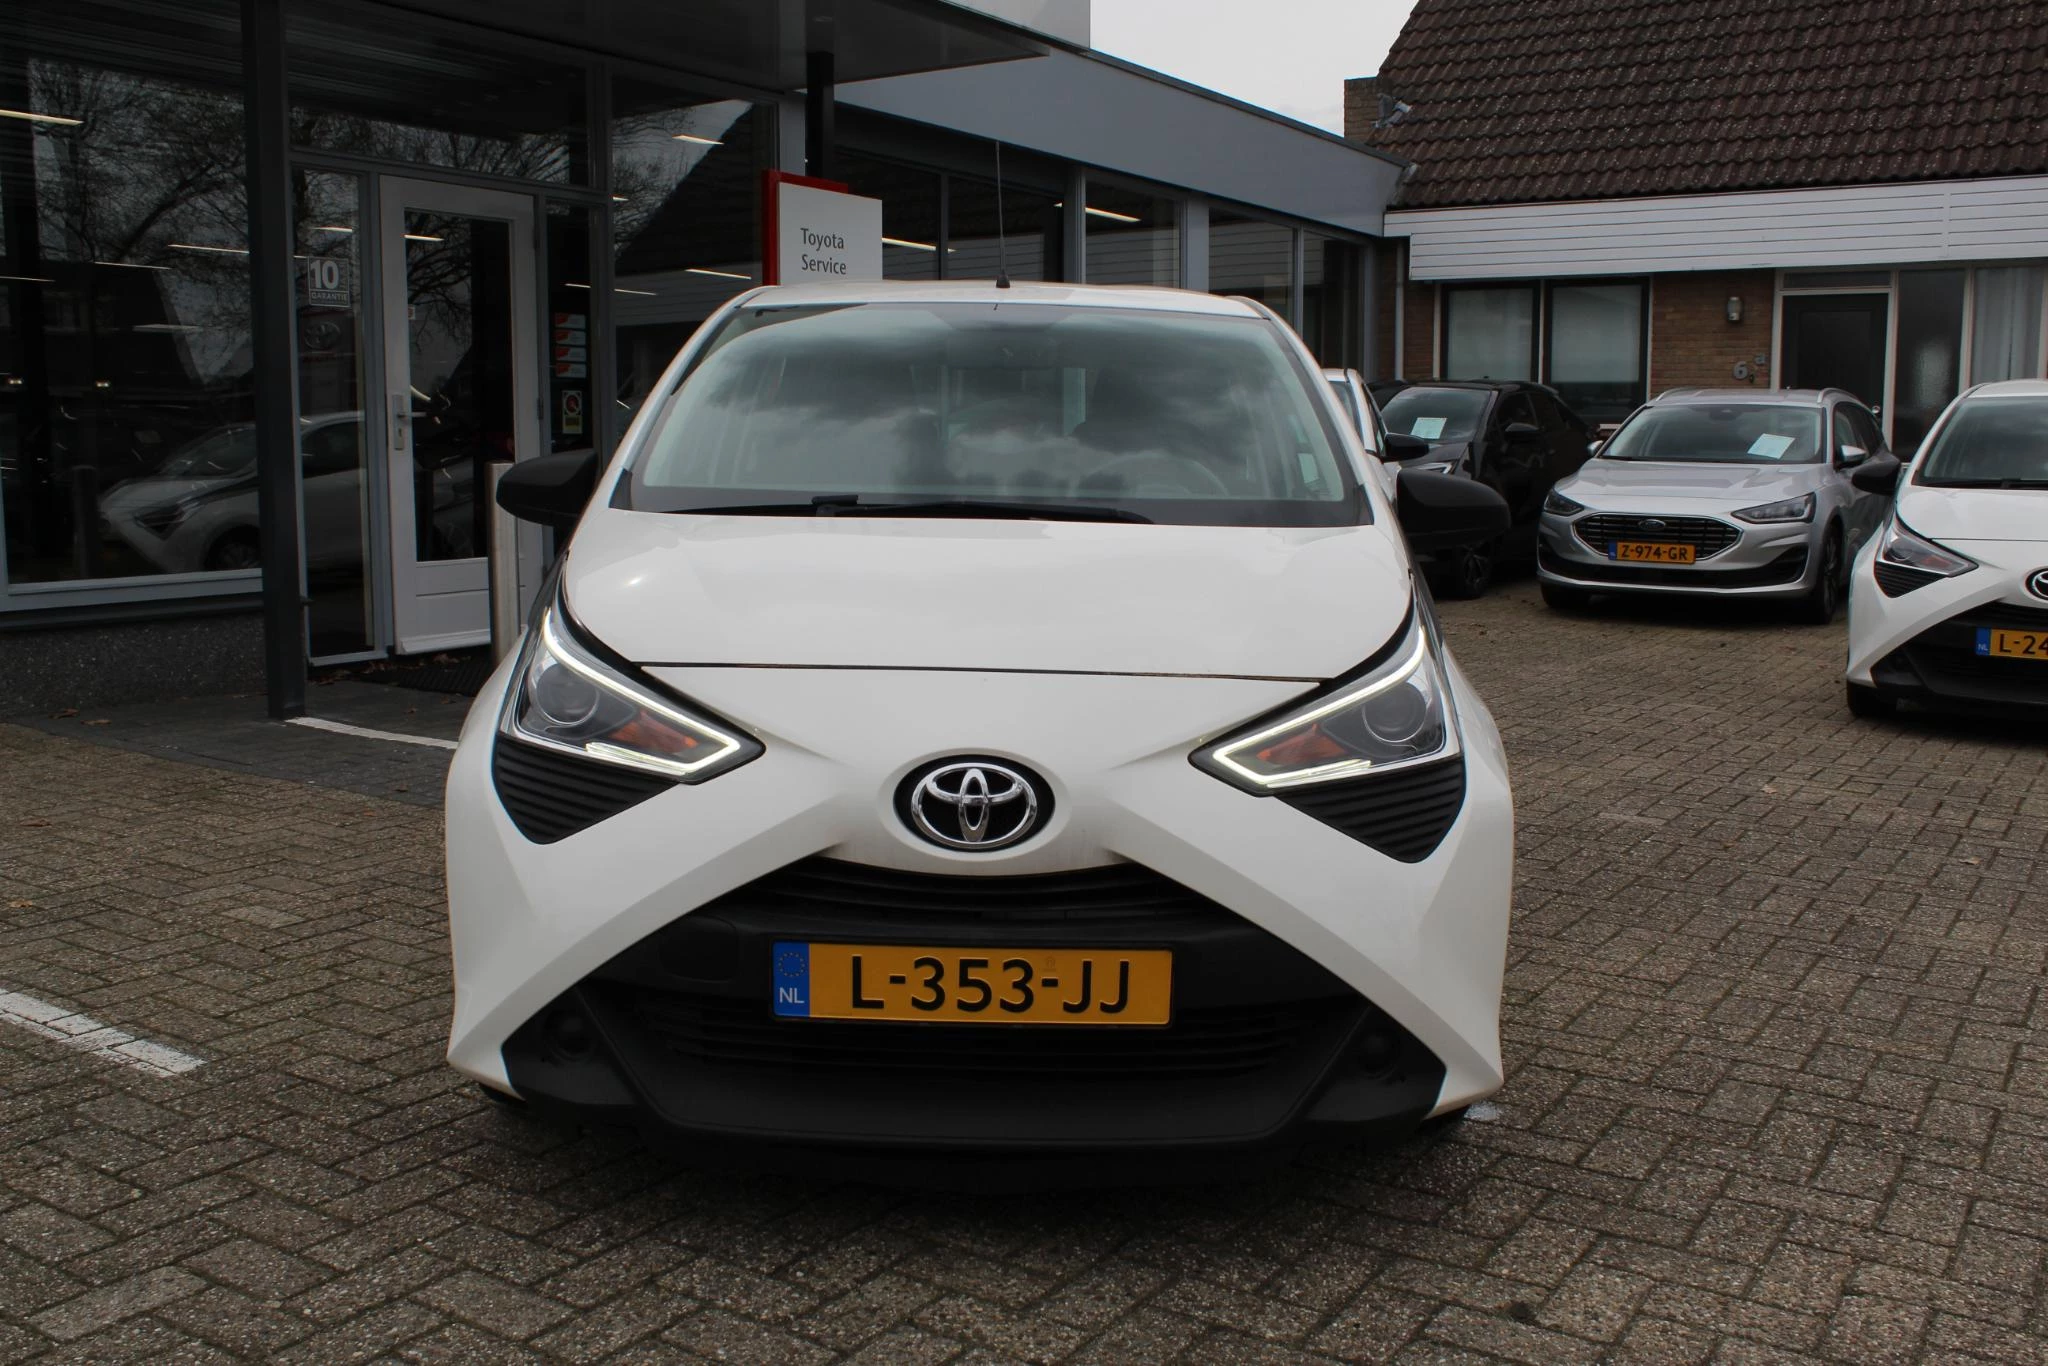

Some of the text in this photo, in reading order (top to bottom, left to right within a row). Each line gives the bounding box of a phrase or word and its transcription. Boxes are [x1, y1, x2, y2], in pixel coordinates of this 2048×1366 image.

[800, 227, 844, 251] Toyota
[310, 260, 339, 289] 10
[801, 254, 847, 275] Service
[1621, 545, 1688, 560] Z-974-GR
[780, 954, 1130, 1013] NL L-353-JJ
